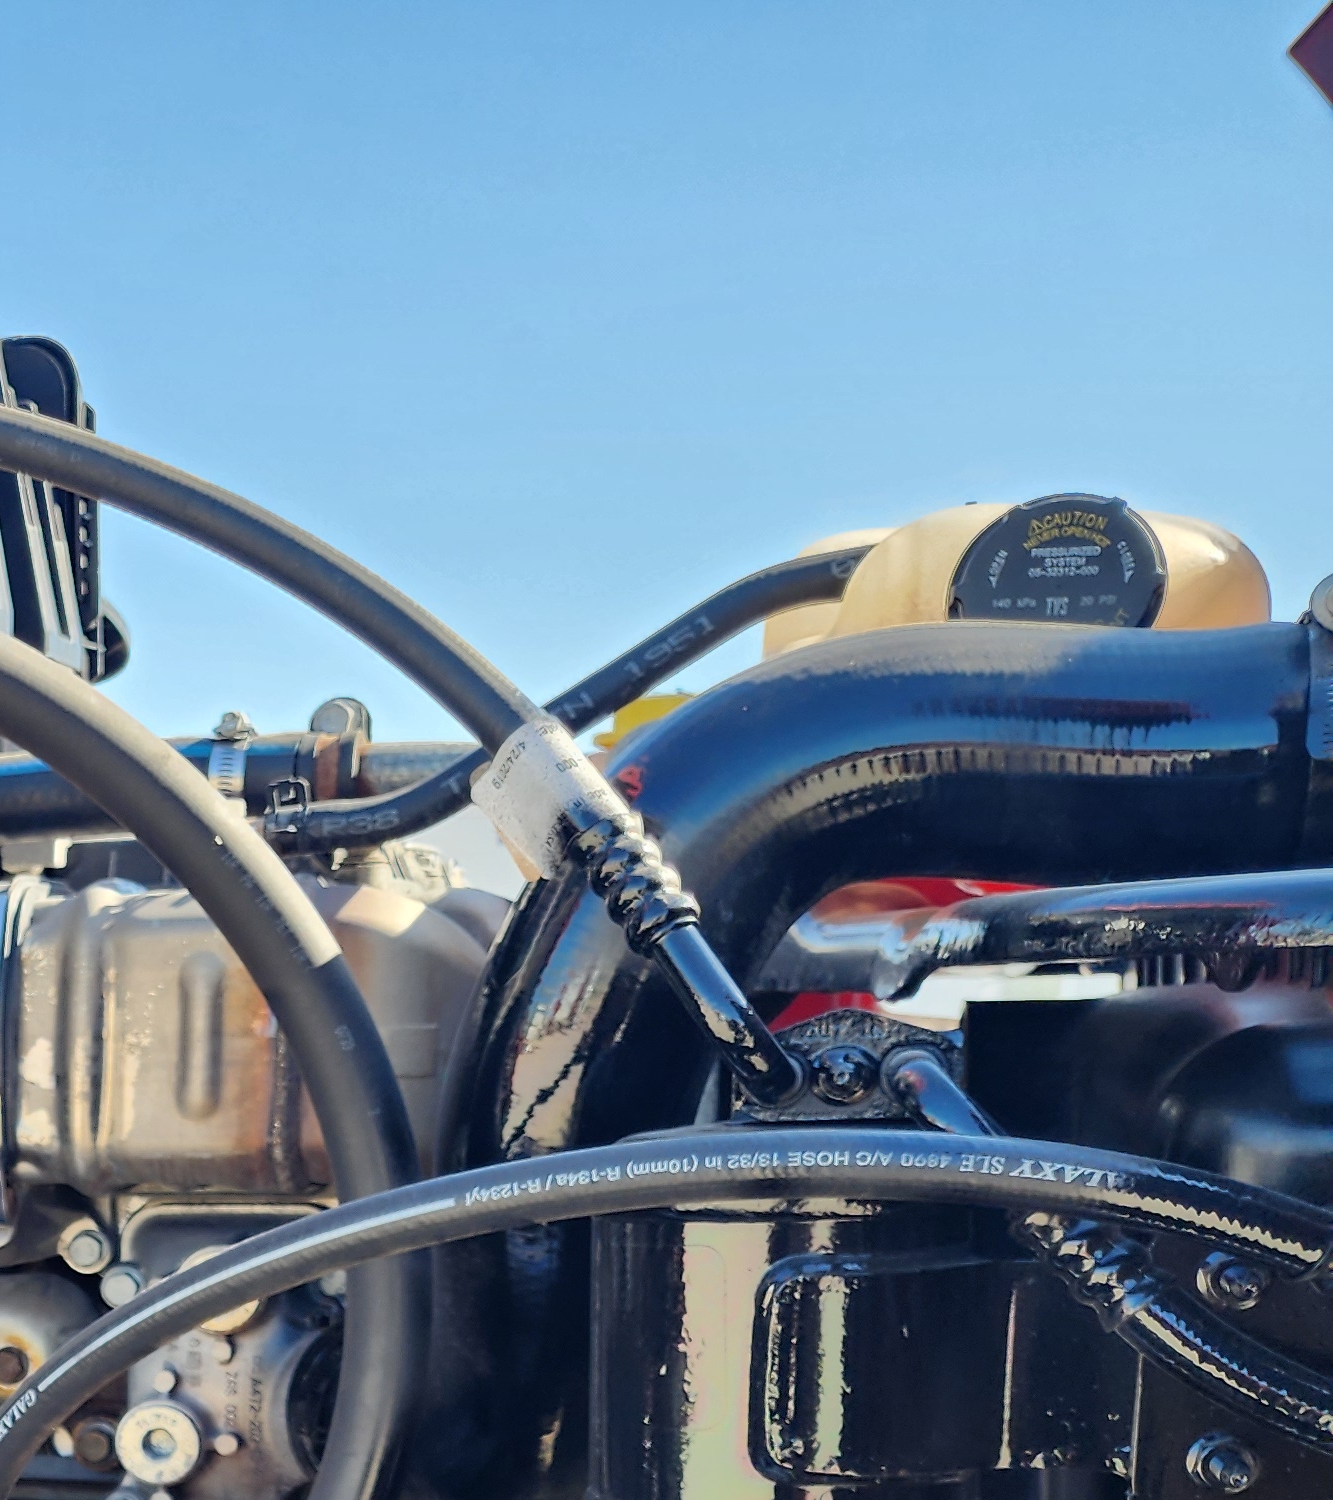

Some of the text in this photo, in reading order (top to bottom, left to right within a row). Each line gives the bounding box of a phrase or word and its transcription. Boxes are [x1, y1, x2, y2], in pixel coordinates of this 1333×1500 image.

[1042, 511, 1109, 531] CAUTION
[1031, 546, 1102, 558] PRESSURIZED
[1045, 557, 1086, 567] SYSTEM
[627, 1154, 700, 1180] (10mm)
[704, 1154, 722, 1169] in
[727, 1151, 780, 1170] 13/32
[787, 1150, 849, 1167] HOSE
[855, 1151, 892, 1168] A/C
[900, 1152, 952, 1168] 4890
[959, 1153, 1006, 1175] SLE
[556, 1165, 621, 1188] R-134a
